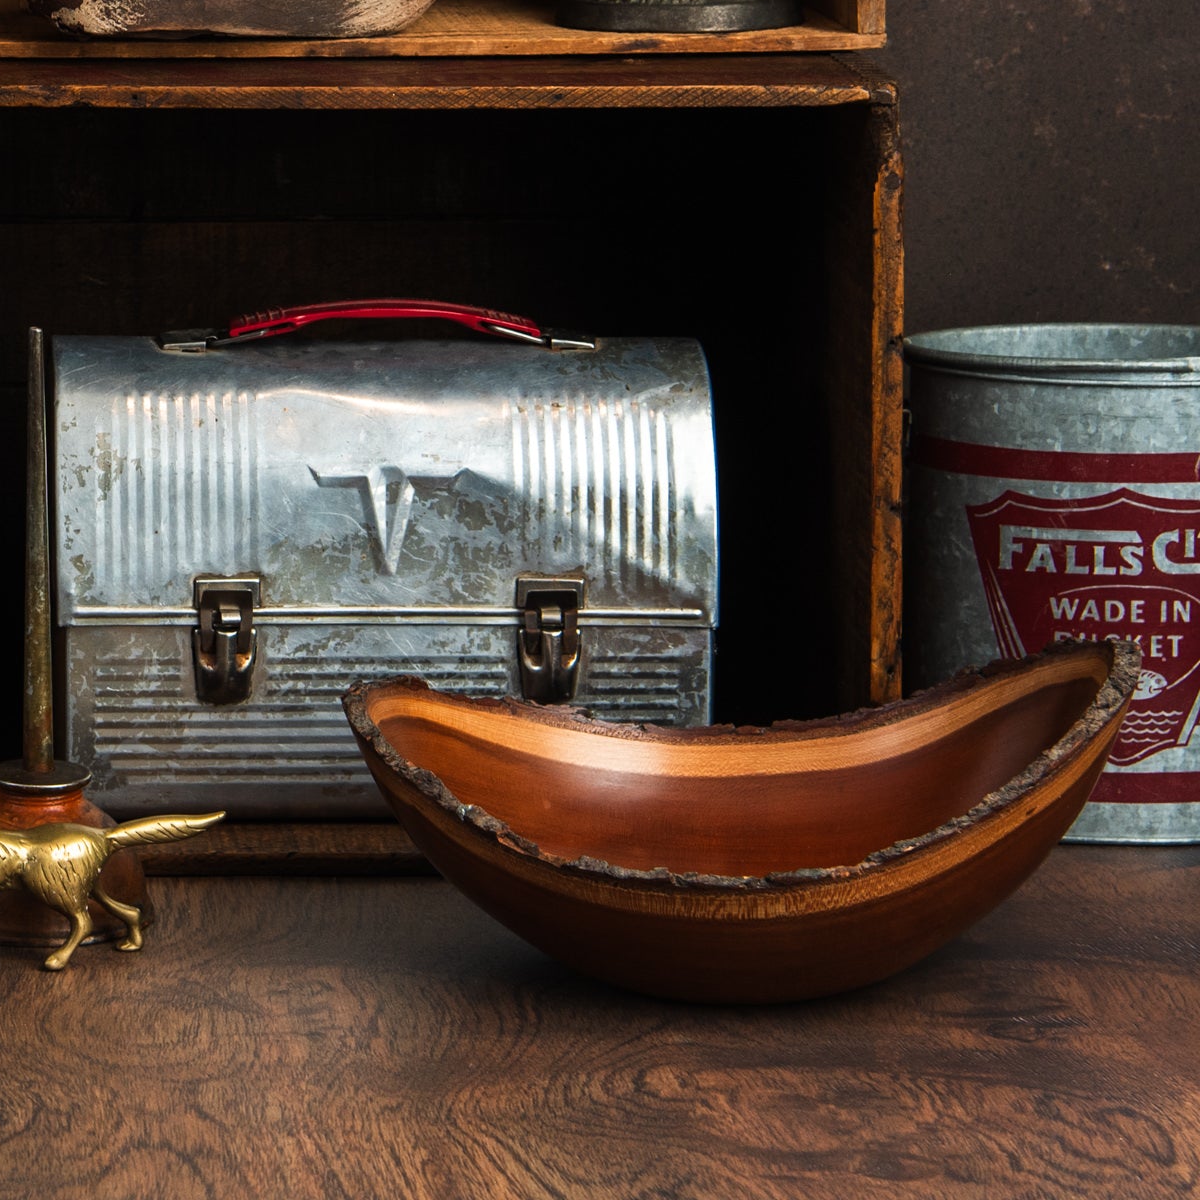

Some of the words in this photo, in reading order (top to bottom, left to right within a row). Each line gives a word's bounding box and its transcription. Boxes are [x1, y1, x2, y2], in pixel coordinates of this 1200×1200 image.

[998, 524, 1144, 576] FALLS
[1049, 597, 1146, 624] WADE
[1160, 600, 1191, 624] IN
